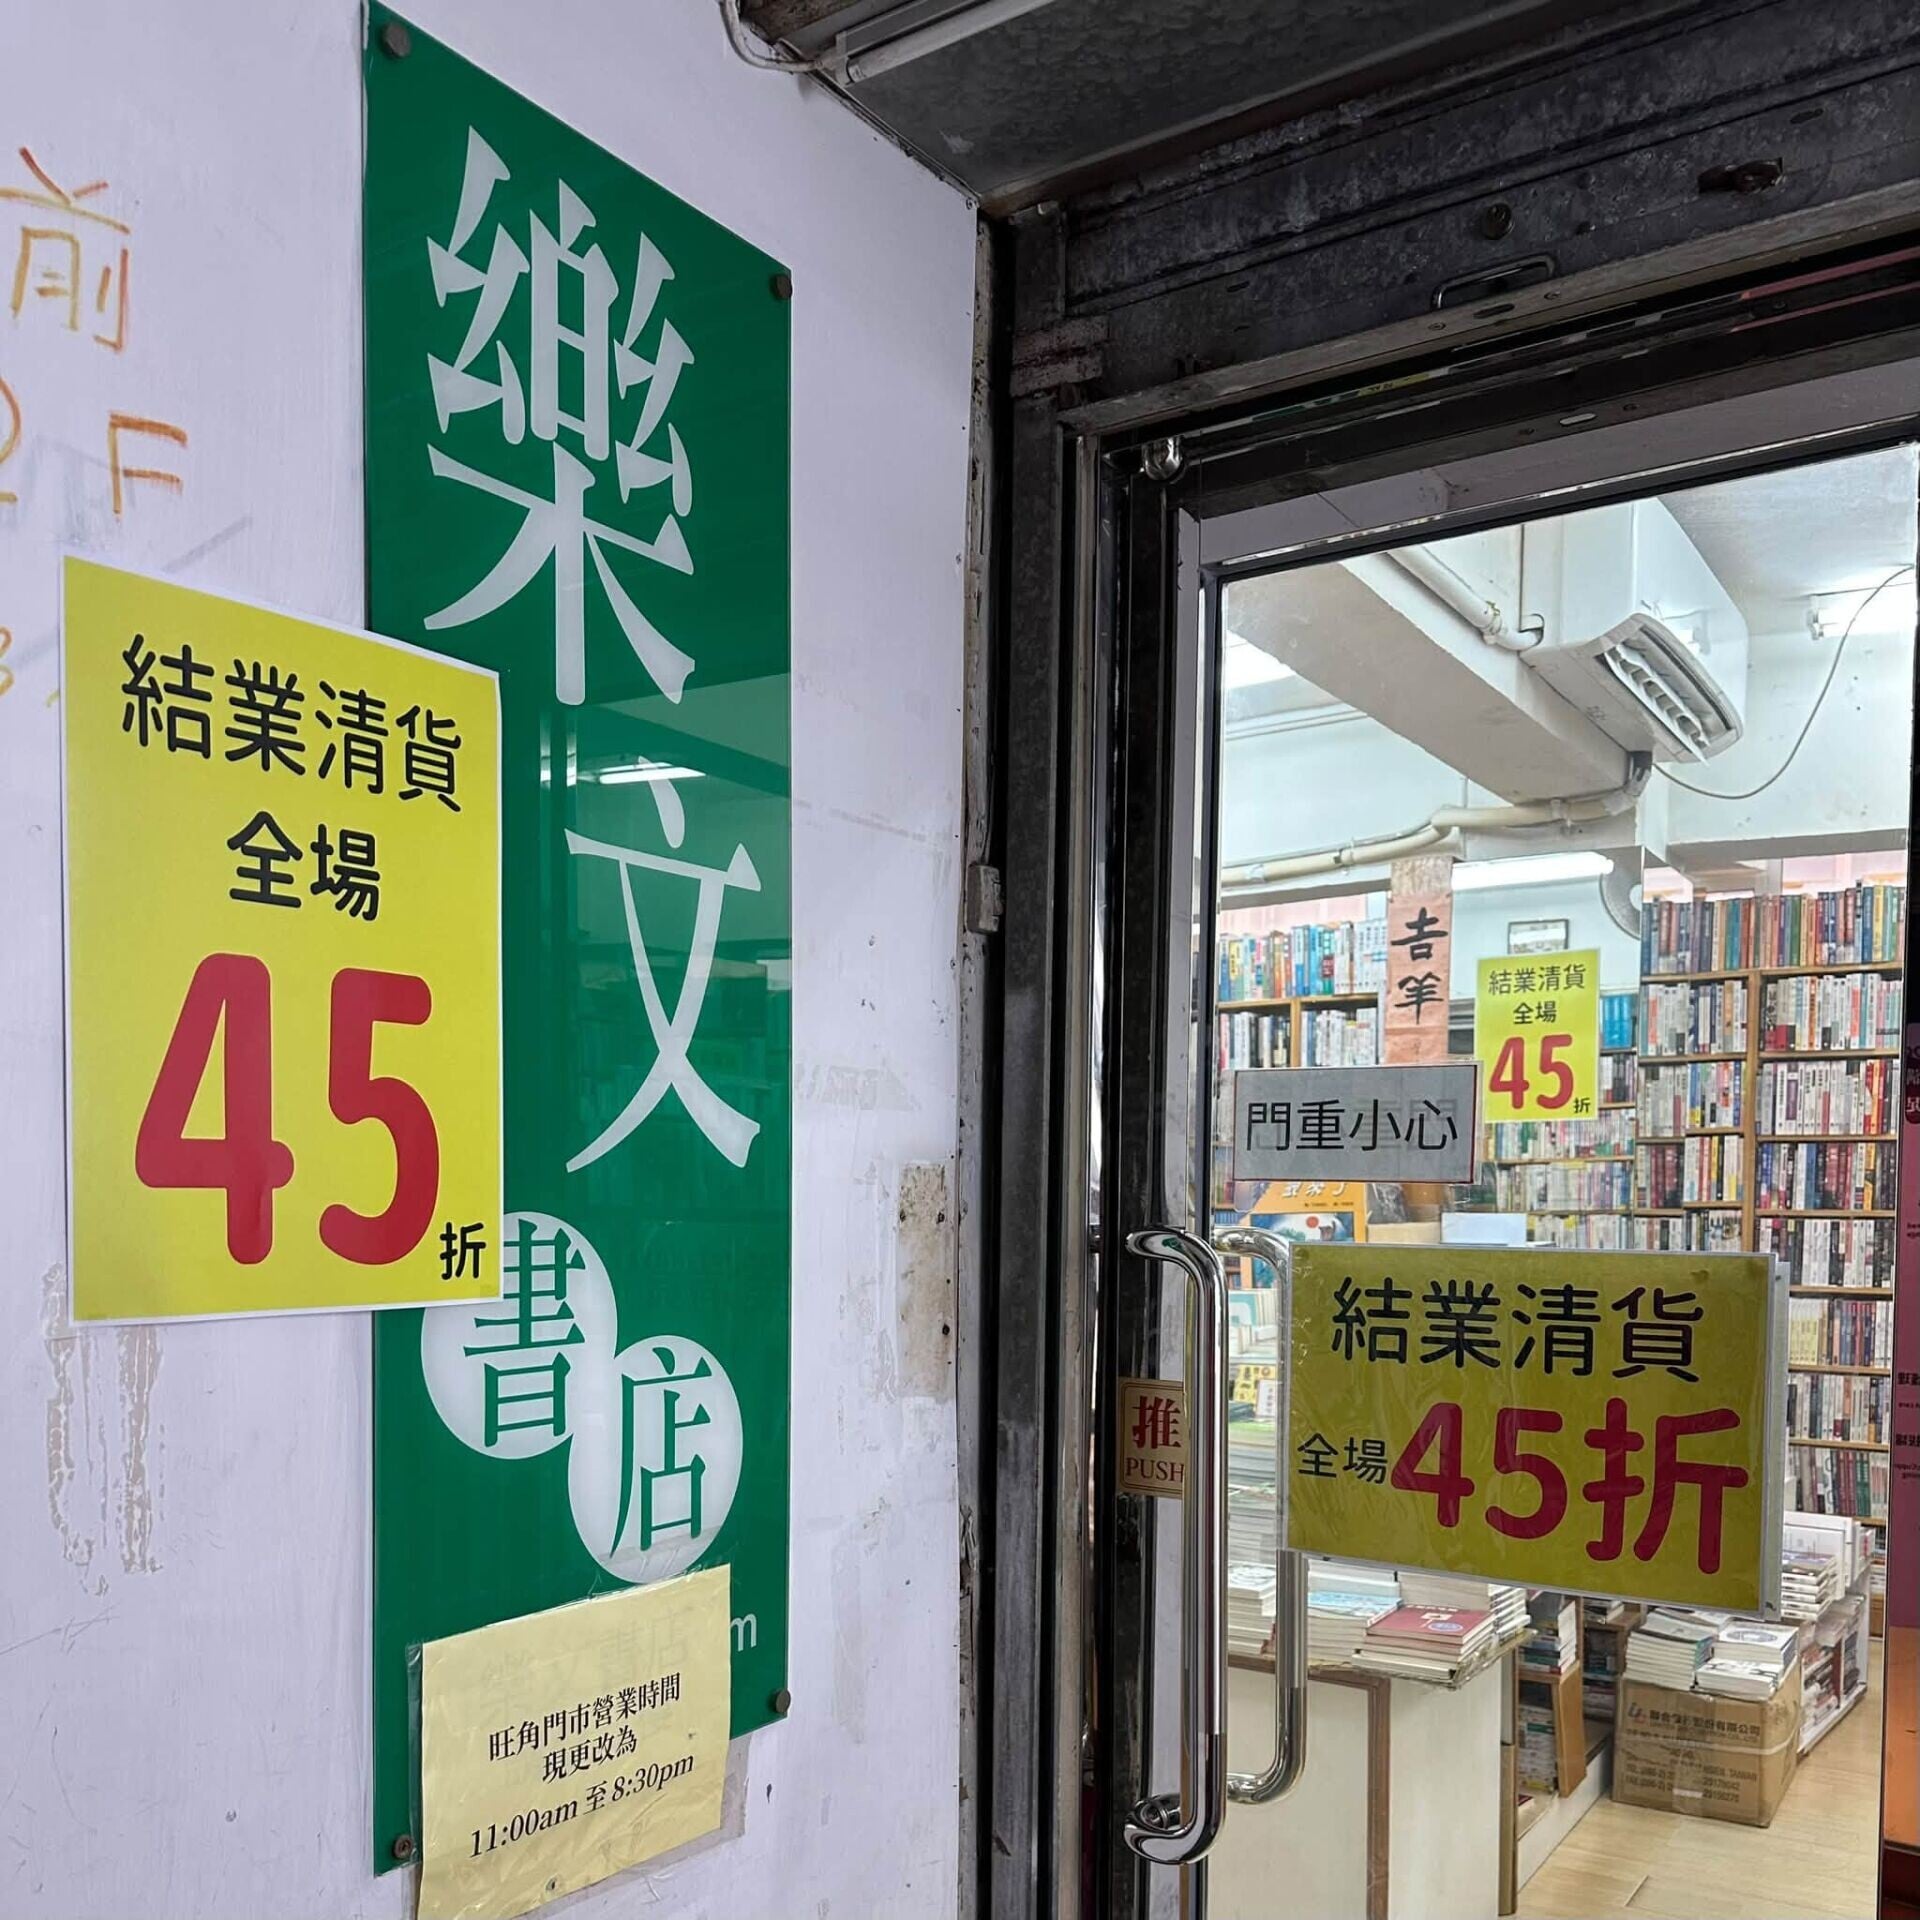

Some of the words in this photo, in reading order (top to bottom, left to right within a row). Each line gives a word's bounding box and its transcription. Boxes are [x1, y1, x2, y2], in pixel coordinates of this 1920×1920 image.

[121, 633, 463, 814] 結業清貨
[226, 810, 382, 922] 全場
[1488, 964, 1587, 995] 結業清貨
[1513, 1002, 1557, 1025] 全場
[1246, 1099, 1458, 1152] 門重小心
[1332, 1276, 1704, 1383] 結業清貨
[1132, 1395, 1182, 1449] 推
[1125, 1457, 1185, 1483] PUSH
[488, 1673, 681, 1761] 旺角門市營業時間
[542, 1725, 637, 1784] 現更改為
[470, 1799, 578, 1858] 11:00am
[583, 1780, 607, 1815] 至
[611, 1755, 694, 1802] 8:30pm
